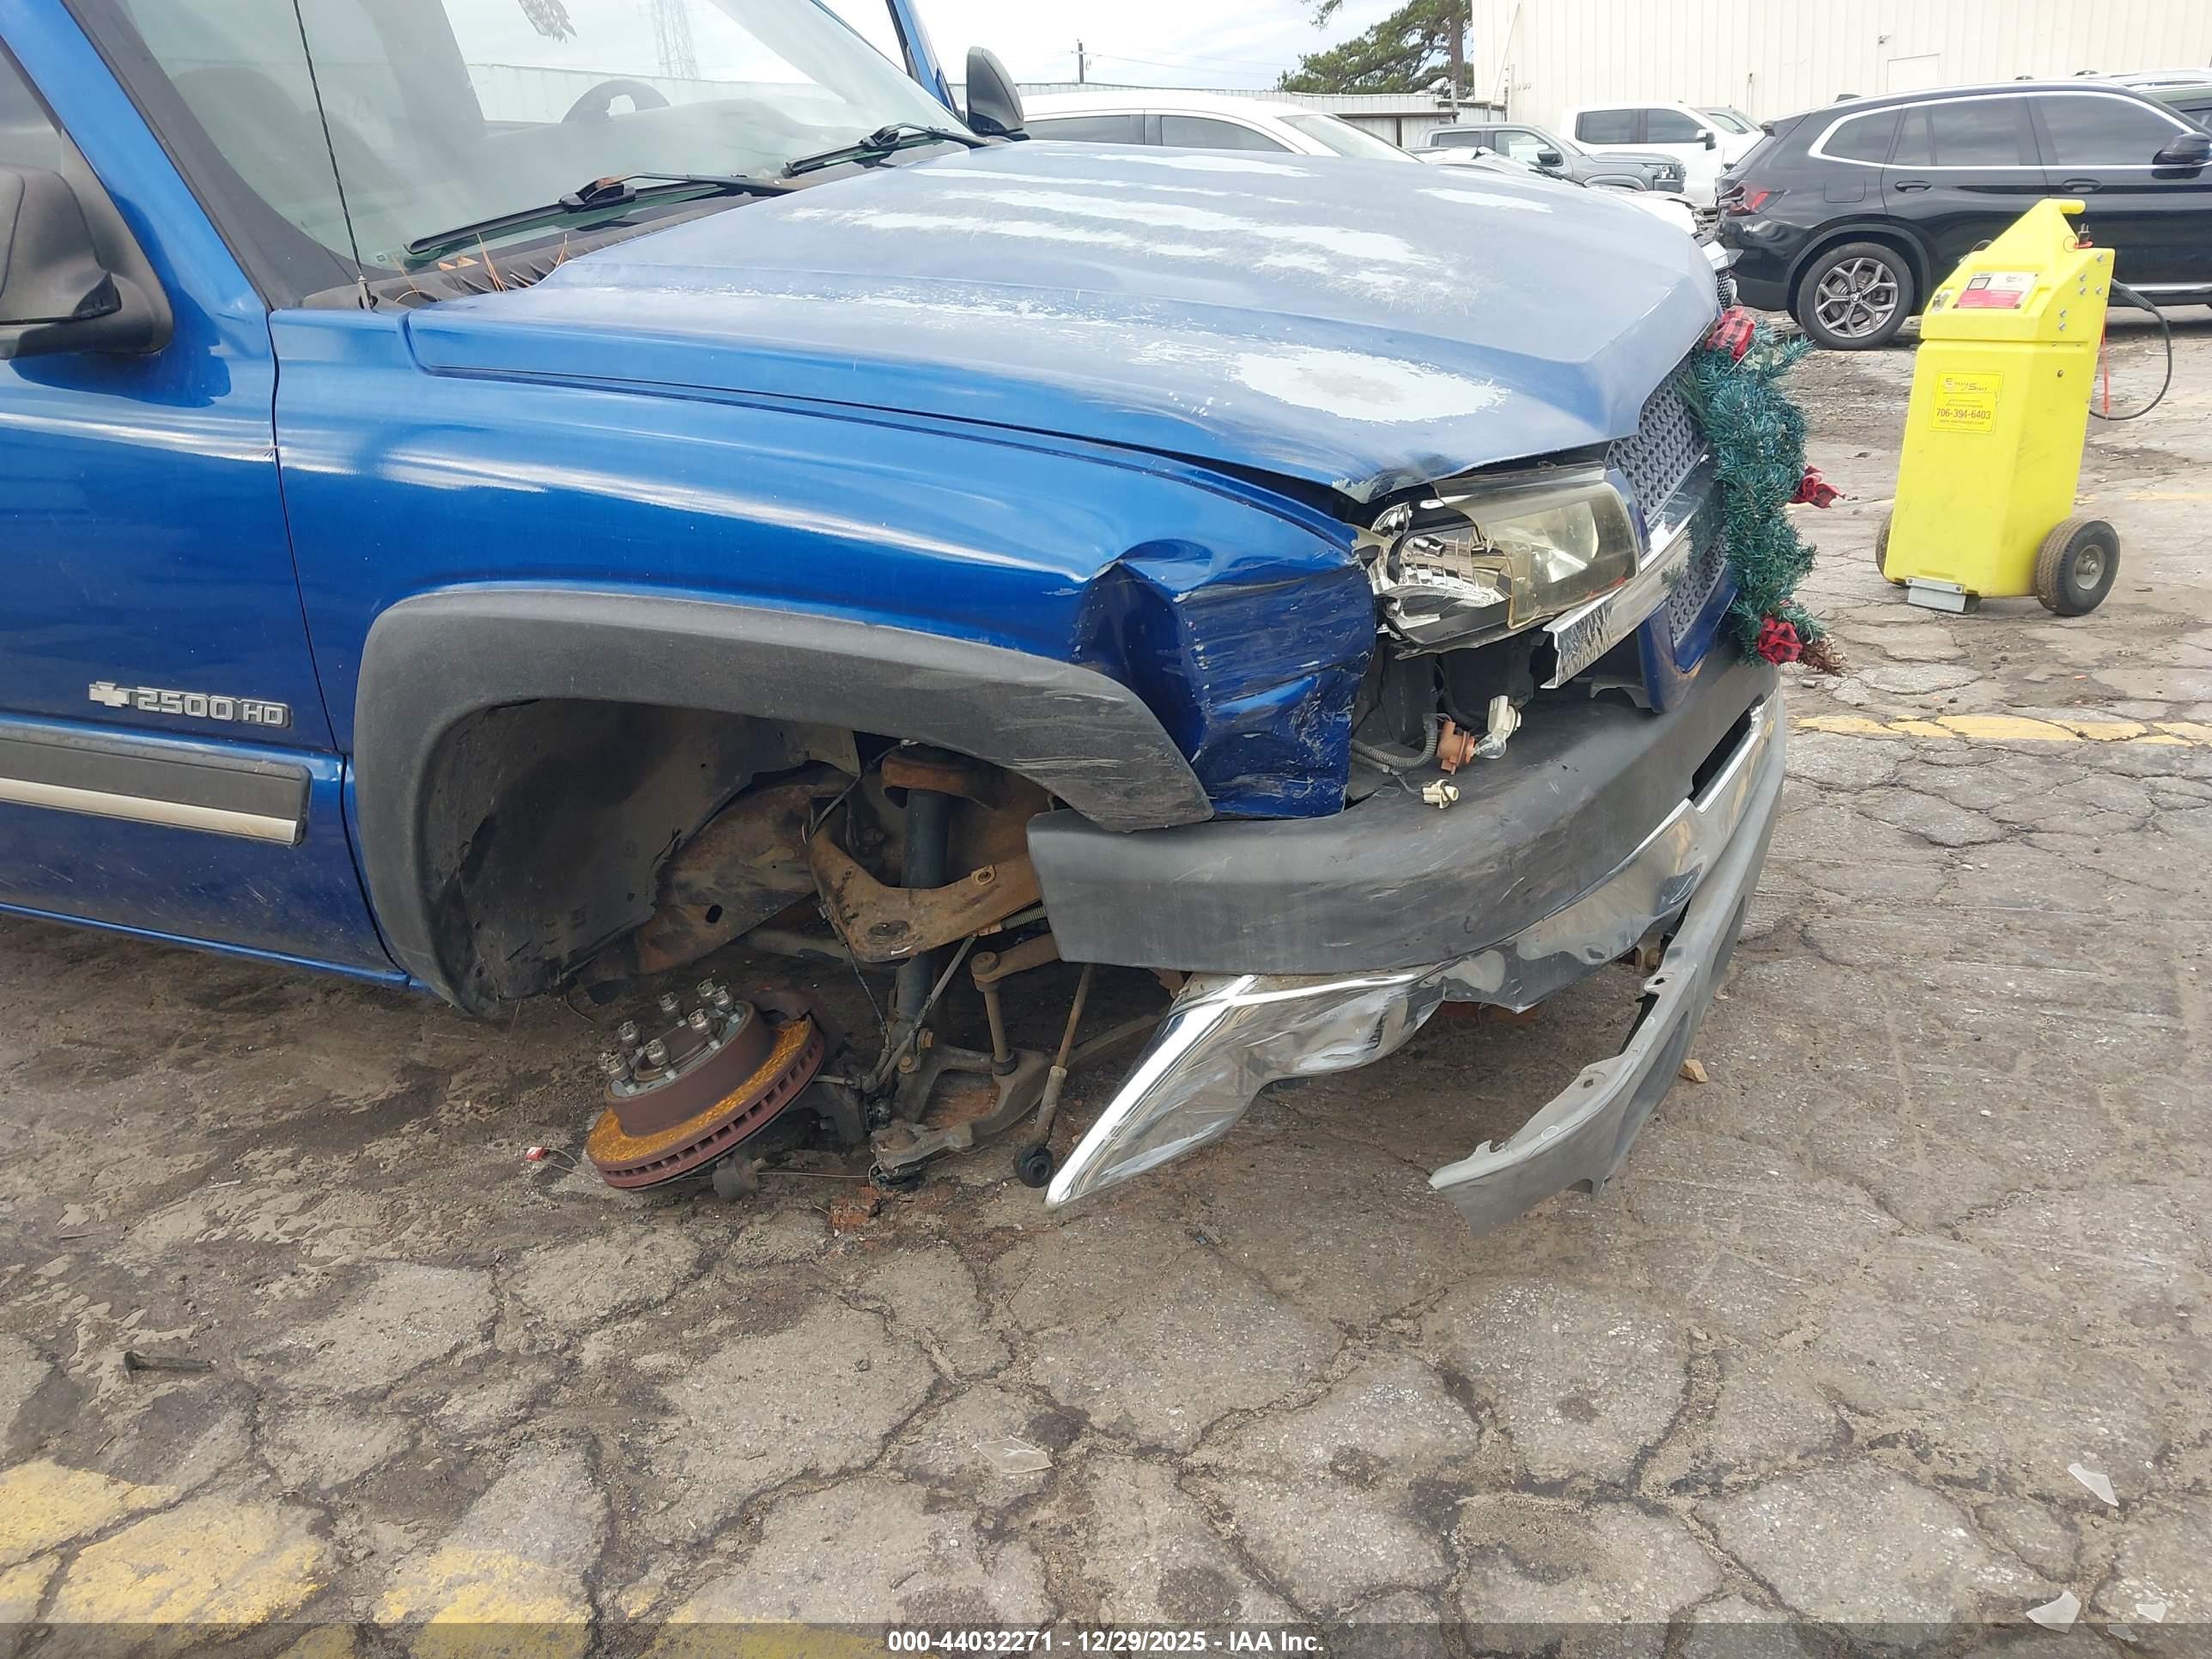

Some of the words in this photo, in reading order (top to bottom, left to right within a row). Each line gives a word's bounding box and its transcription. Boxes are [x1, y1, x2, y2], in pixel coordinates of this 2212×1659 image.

[1936, 408, 1991, 420] 706-394-6403
[137, 690, 234, 721] 2500
[242, 703, 284, 726] HD
